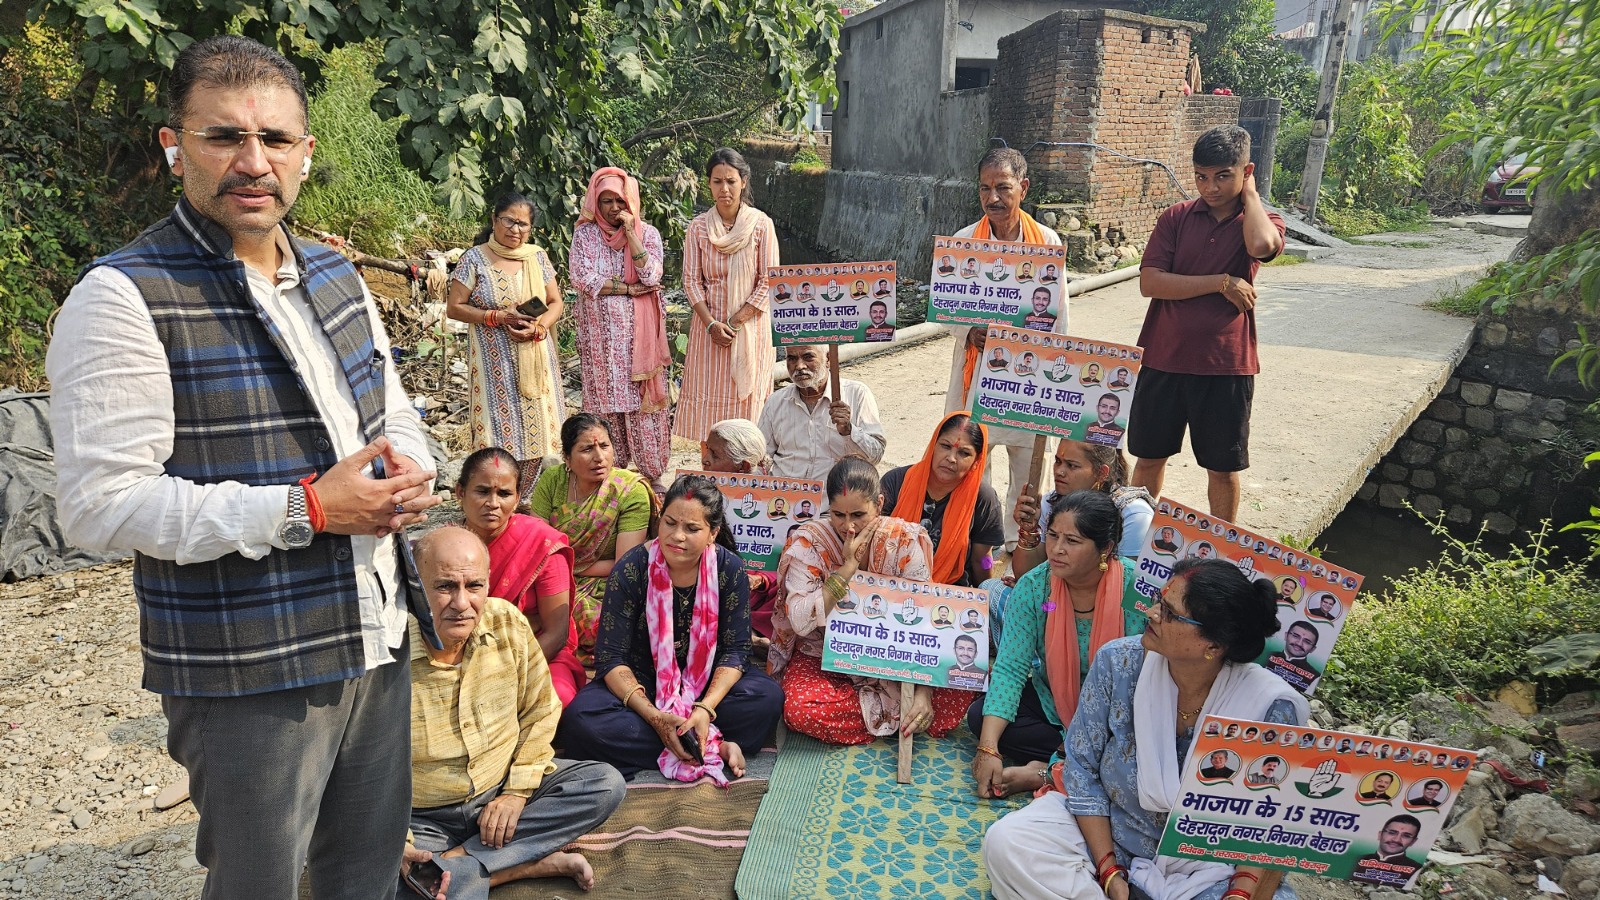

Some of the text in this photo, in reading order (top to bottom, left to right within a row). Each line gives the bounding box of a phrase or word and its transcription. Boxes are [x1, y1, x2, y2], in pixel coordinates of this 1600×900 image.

[933, 281, 1022, 300] भाजपा के 15 साल,
[773, 304, 859, 318] भाजपा के 15 साल,
[981, 376, 1086, 406] भाजपा के 15 साल,
[979, 393, 1081, 422] देहरादून नगर निगम बेहाल
[733, 524, 775, 539] 15 साल,
[750, 540, 772, 554] बेहाल
[1140, 558, 1174, 581] भाज
[830, 619, 941, 650] भाजपा के 15 साल,
[830, 637, 939, 666] देहरादून नगर निगम बेहाल
[1182, 791, 1360, 832] भाजपा के 15 साल,
[1177, 815, 1350, 854] देहरादून नगर निगम बेहाल
